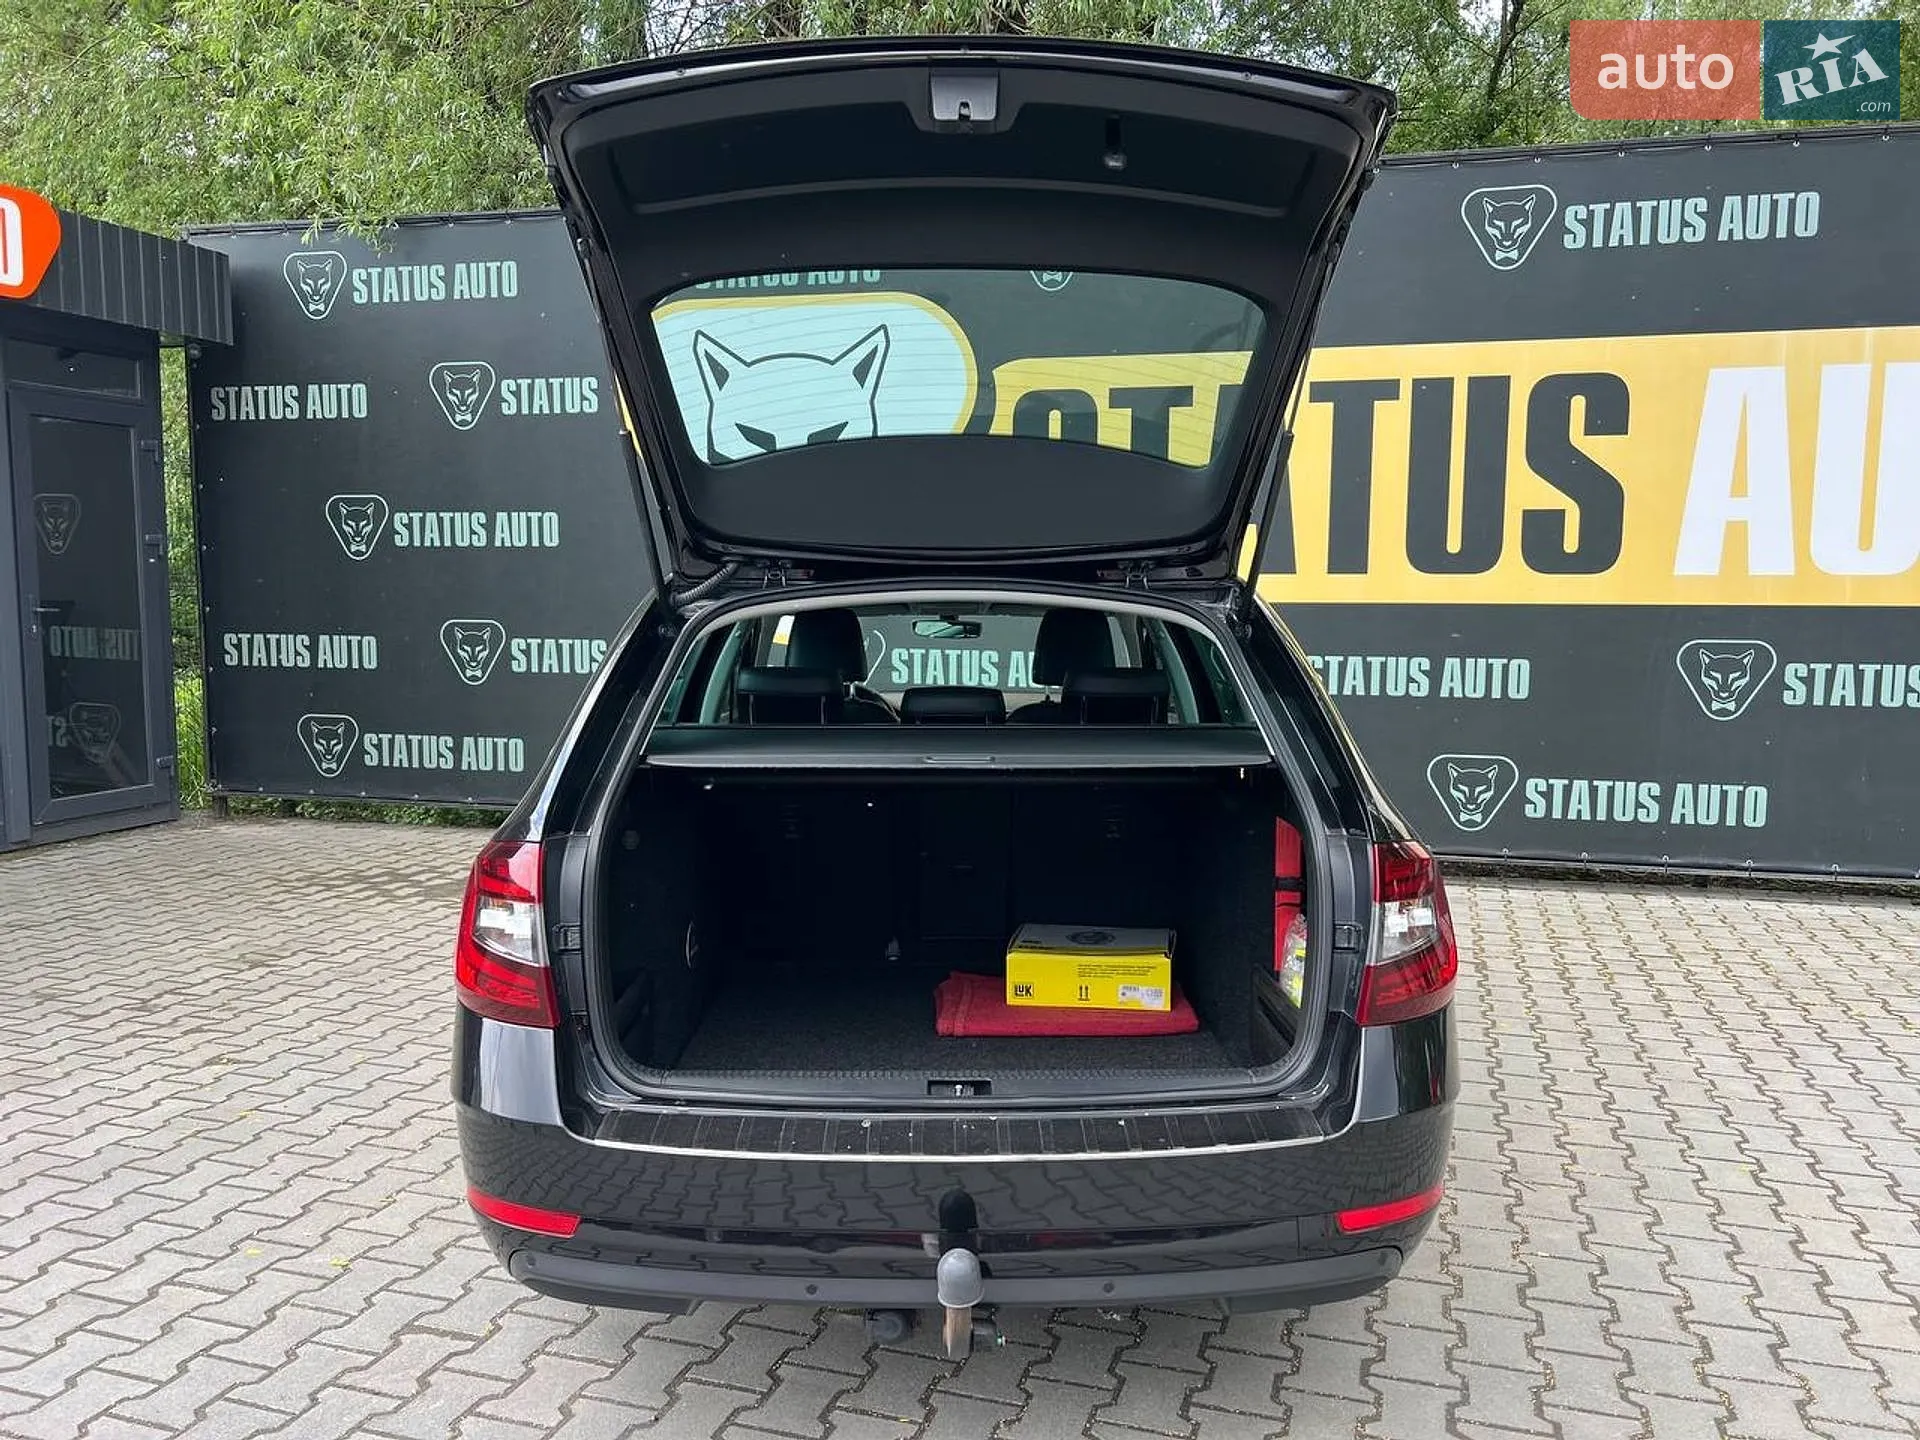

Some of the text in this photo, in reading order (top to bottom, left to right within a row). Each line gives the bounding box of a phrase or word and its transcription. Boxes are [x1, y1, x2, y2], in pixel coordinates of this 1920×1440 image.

[1563, 191, 1820, 249] STATUS AUTO
[352, 260, 518, 304] STATUS AUTO
[211, 383, 368, 420] STATUS AUTO
[500, 376, 599, 415] STATUS
[393, 511, 560, 547] STATUS AUTO
[223, 633, 378, 670] STATUS AUTO
[511, 637, 608, 674] STATUS
[891, 648, 999, 688] STATUS
[1439, 657, 1530, 699] AUTO
[1783, 662, 1920, 708] STATUS
[363, 733, 525, 773] STATUS AUTO
[1524, 778, 1768, 828] STATUS AUTO
